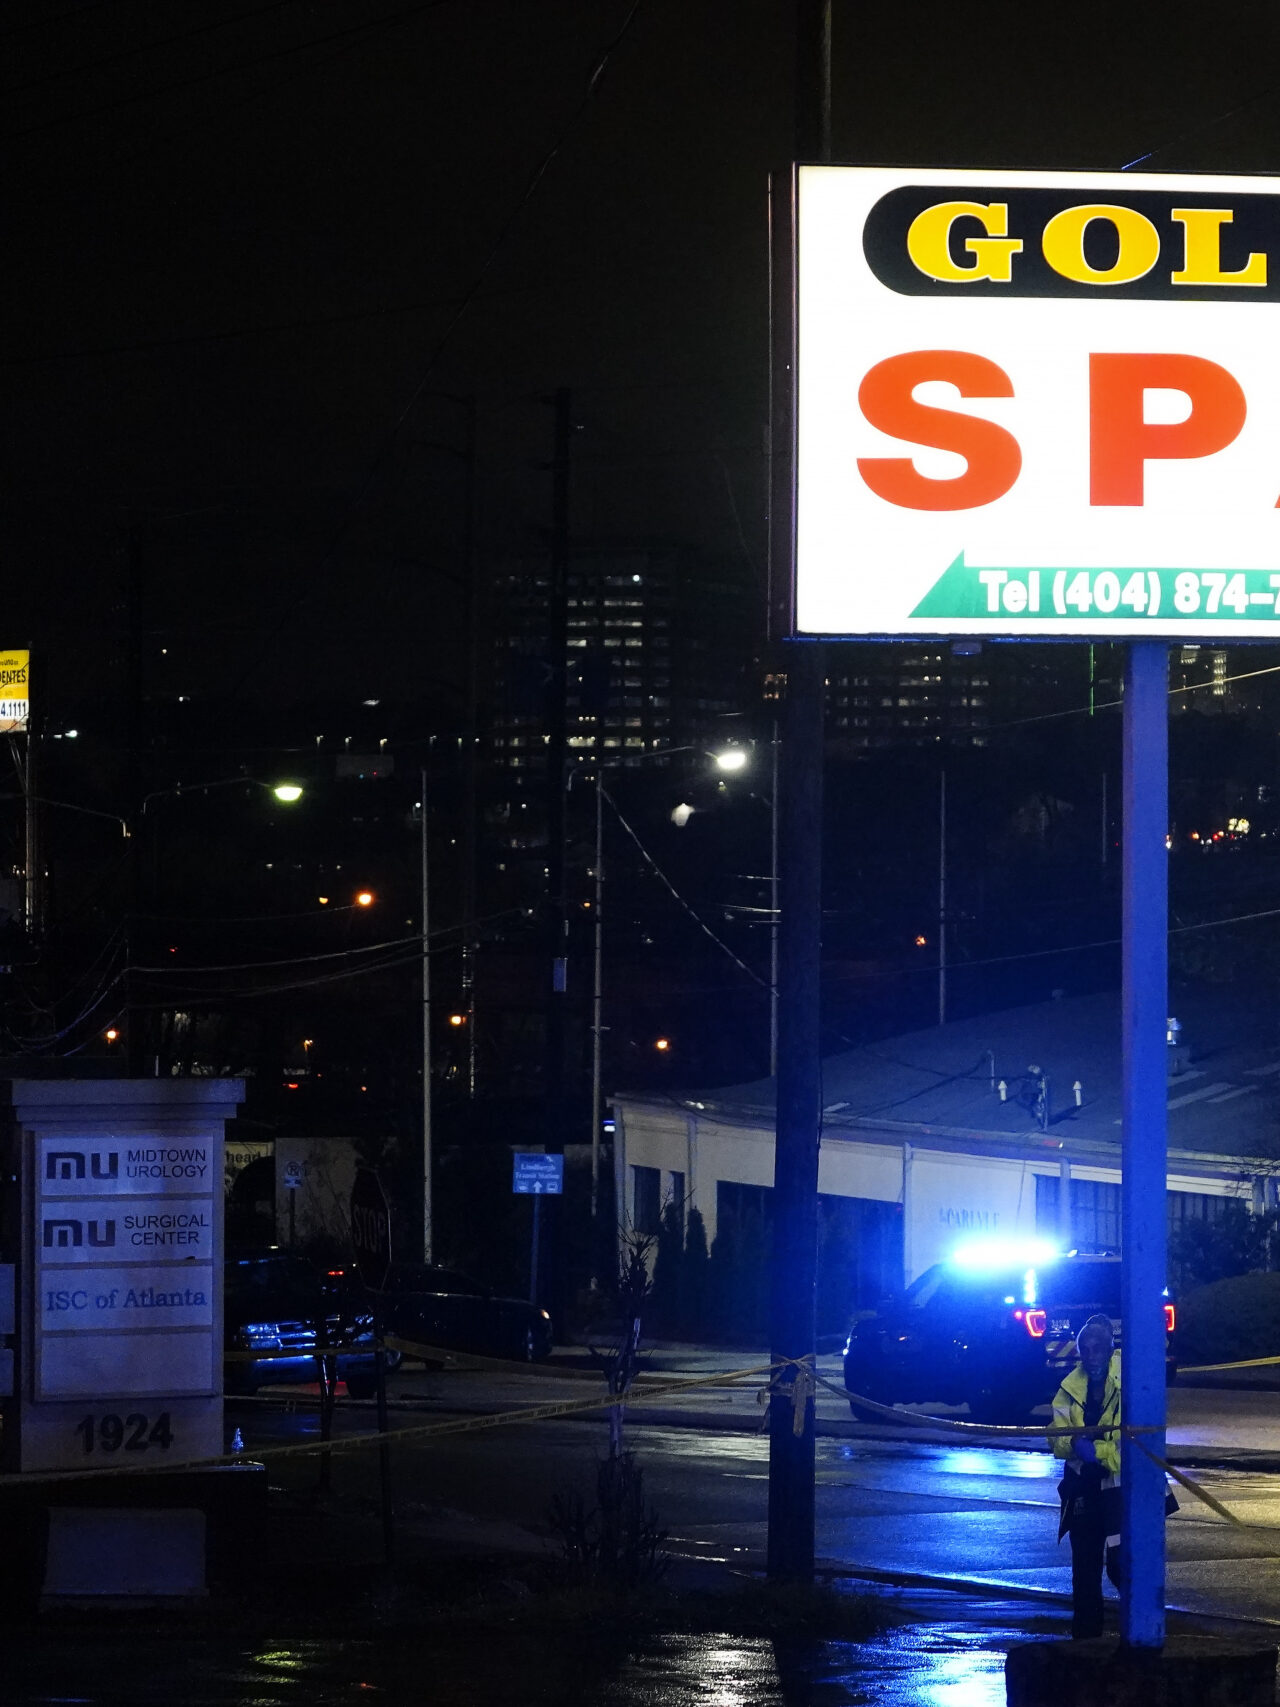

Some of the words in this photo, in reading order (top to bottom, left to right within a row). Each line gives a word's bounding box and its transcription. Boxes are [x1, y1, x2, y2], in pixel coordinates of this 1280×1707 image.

[978, 570, 1041, 613] Tel
[1052, 570, 1162, 616] (404)
[127, 1149, 206, 1163] MIDTOWN
[126, 1165, 207, 1178] UROLOGY
[124, 1214, 209, 1229] SURGICAL
[353, 1204, 386, 1254] STOP
[131, 1231, 200, 1245] CENTER
[46, 1290, 88, 1311] ISC
[96, 1289, 119, 1309] of
[123, 1287, 208, 1308] Atlanta
[74, 1411, 174, 1453] 1924
